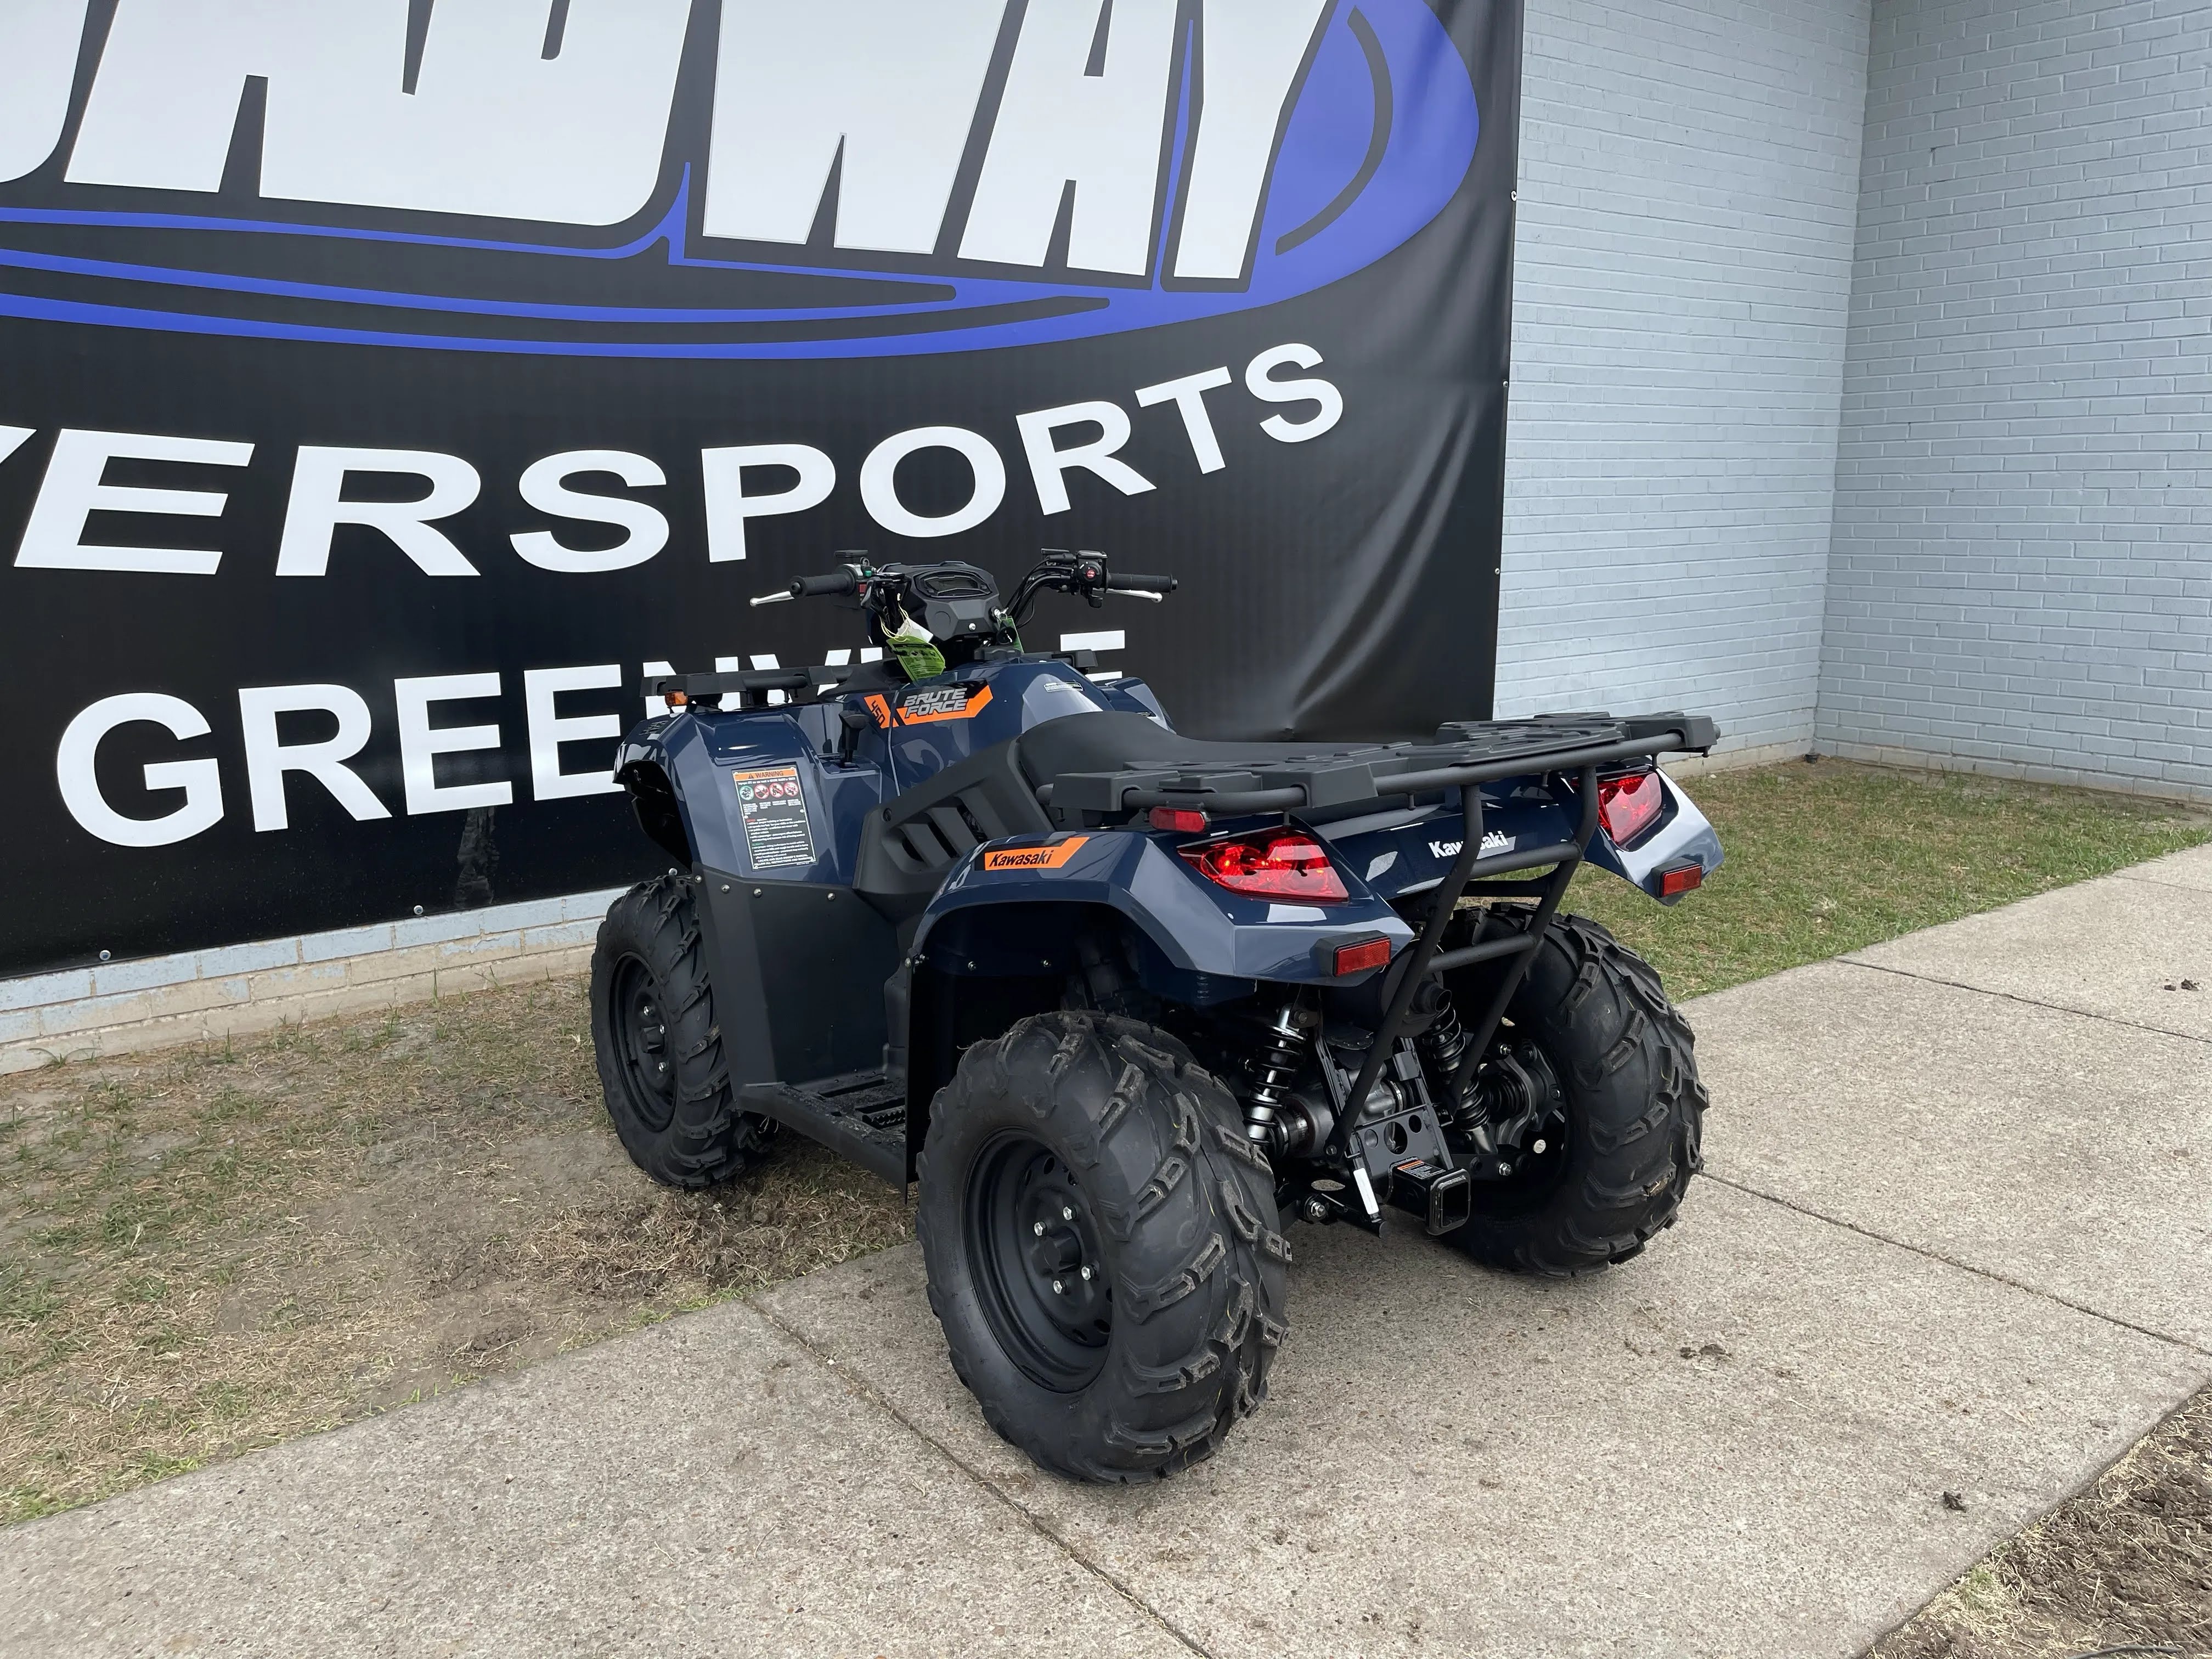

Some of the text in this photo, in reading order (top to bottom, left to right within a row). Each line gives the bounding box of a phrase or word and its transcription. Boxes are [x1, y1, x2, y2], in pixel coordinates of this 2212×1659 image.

[904, 687, 968, 707] BRUTE
[871, 699, 886, 725] 450
[905, 698, 969, 719] FORCE
[989, 850, 1054, 867] Kawasaki
